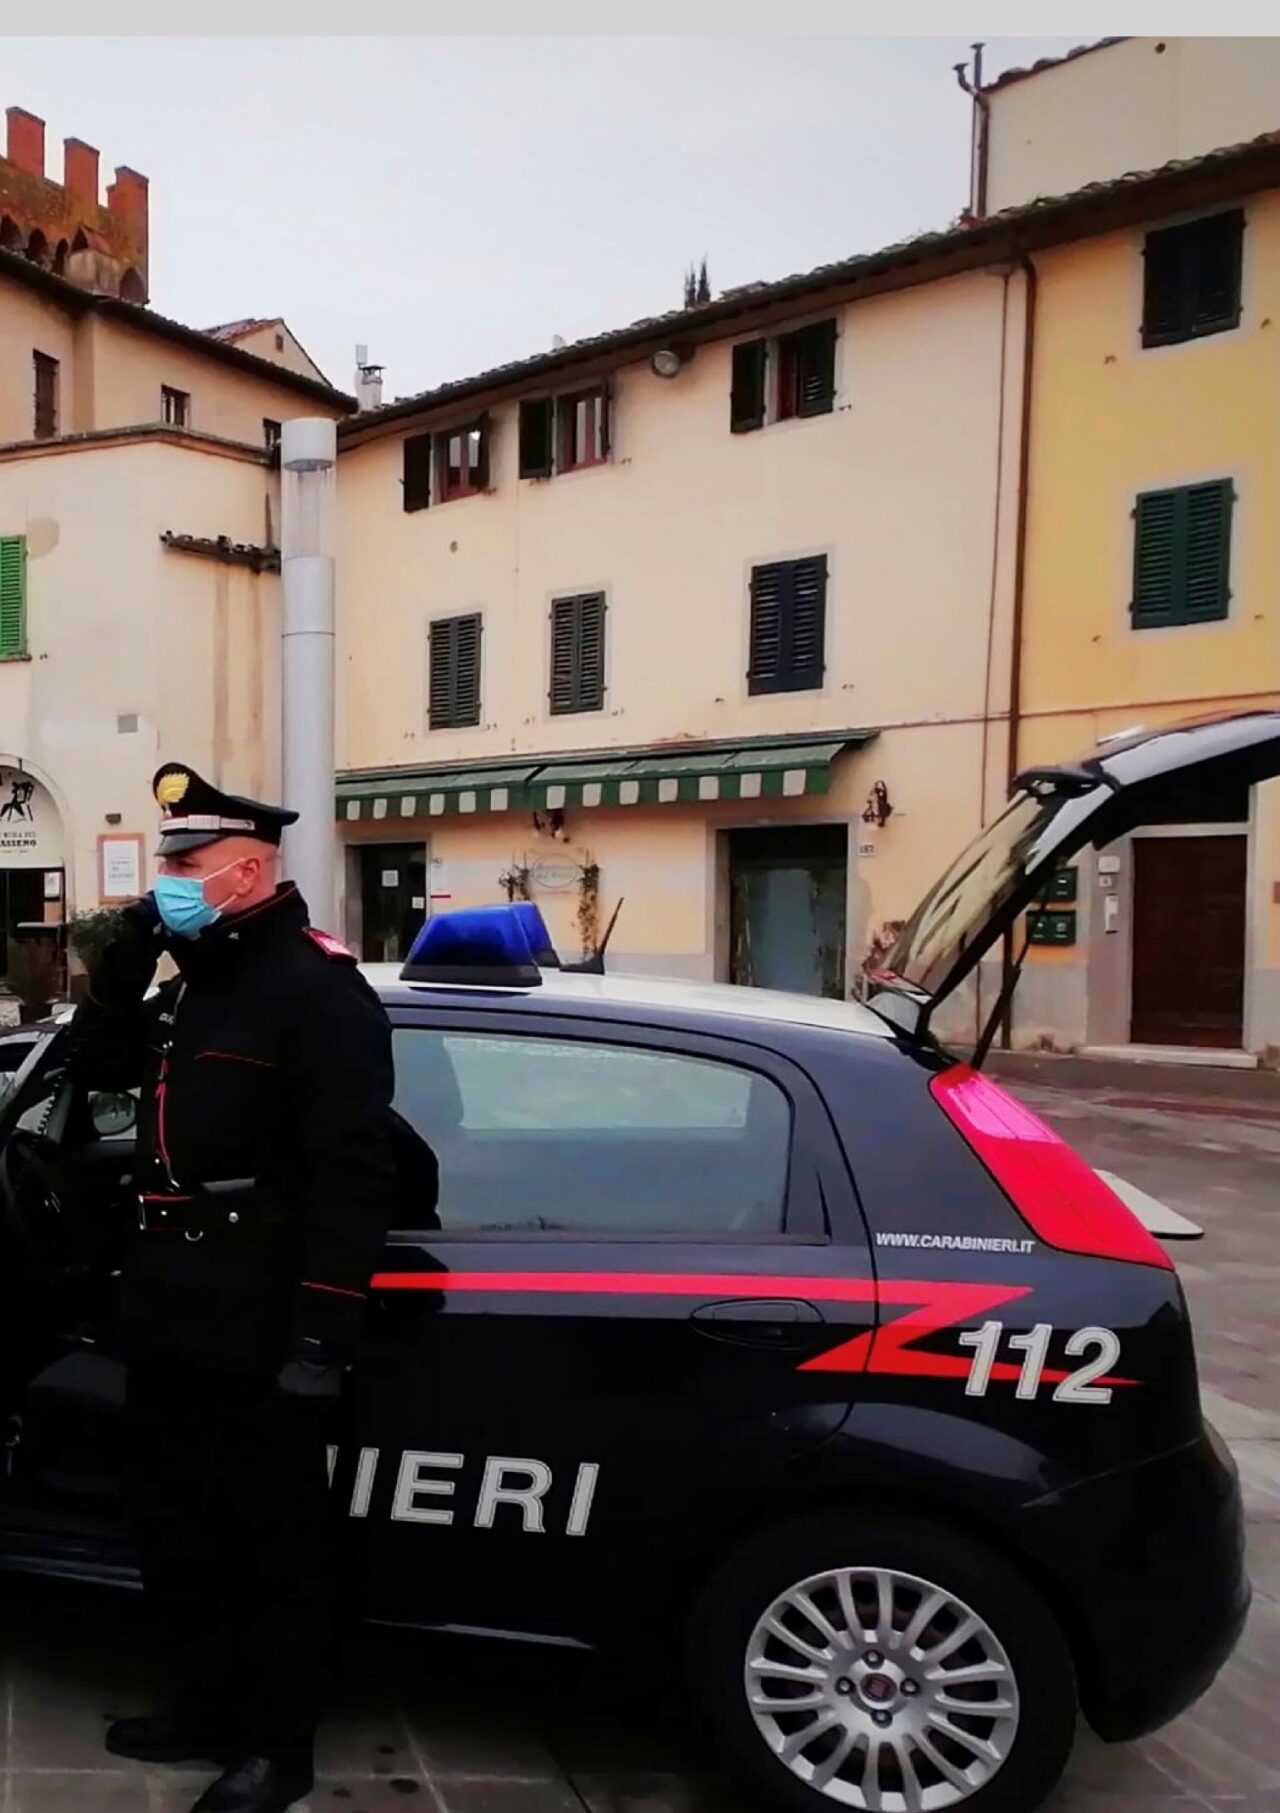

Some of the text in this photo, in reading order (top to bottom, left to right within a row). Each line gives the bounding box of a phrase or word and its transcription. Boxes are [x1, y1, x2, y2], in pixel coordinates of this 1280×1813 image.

[876, 1232, 1035, 1254] WWW.CARABINIERI.IT
[958, 1320, 1121, 1405] 112
[325, 1444, 601, 1537] IERI
